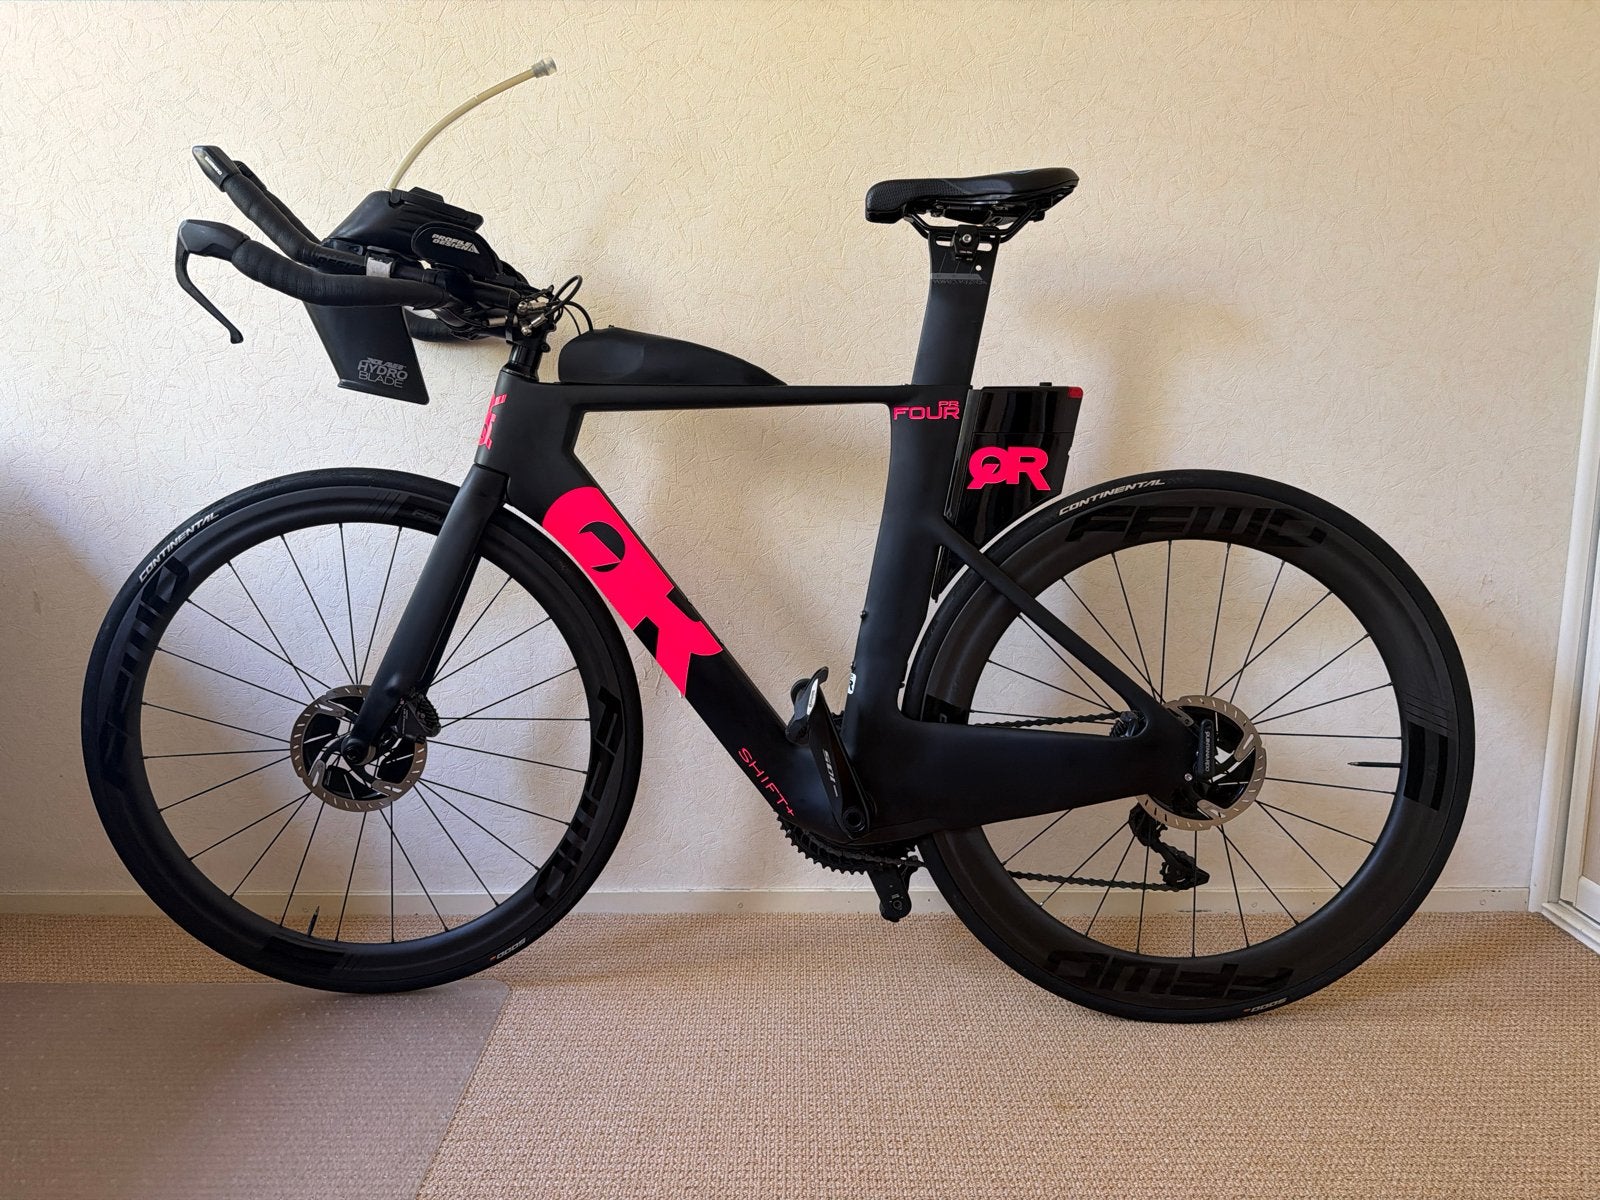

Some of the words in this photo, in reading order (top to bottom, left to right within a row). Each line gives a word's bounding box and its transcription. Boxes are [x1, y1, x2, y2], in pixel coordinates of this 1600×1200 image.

[431, 233, 472, 249] PROFILE
[432, 239, 469, 252] DESIGN
[357, 359, 408, 380] HYDRO
[358, 370, 404, 388] BLADE
[893, 406, 960, 420] FOUR
[966, 446, 1051, 490] QR
[1058, 477, 1166, 516] CONTINENTAL
[137, 511, 220, 584] CONTINENTAL
